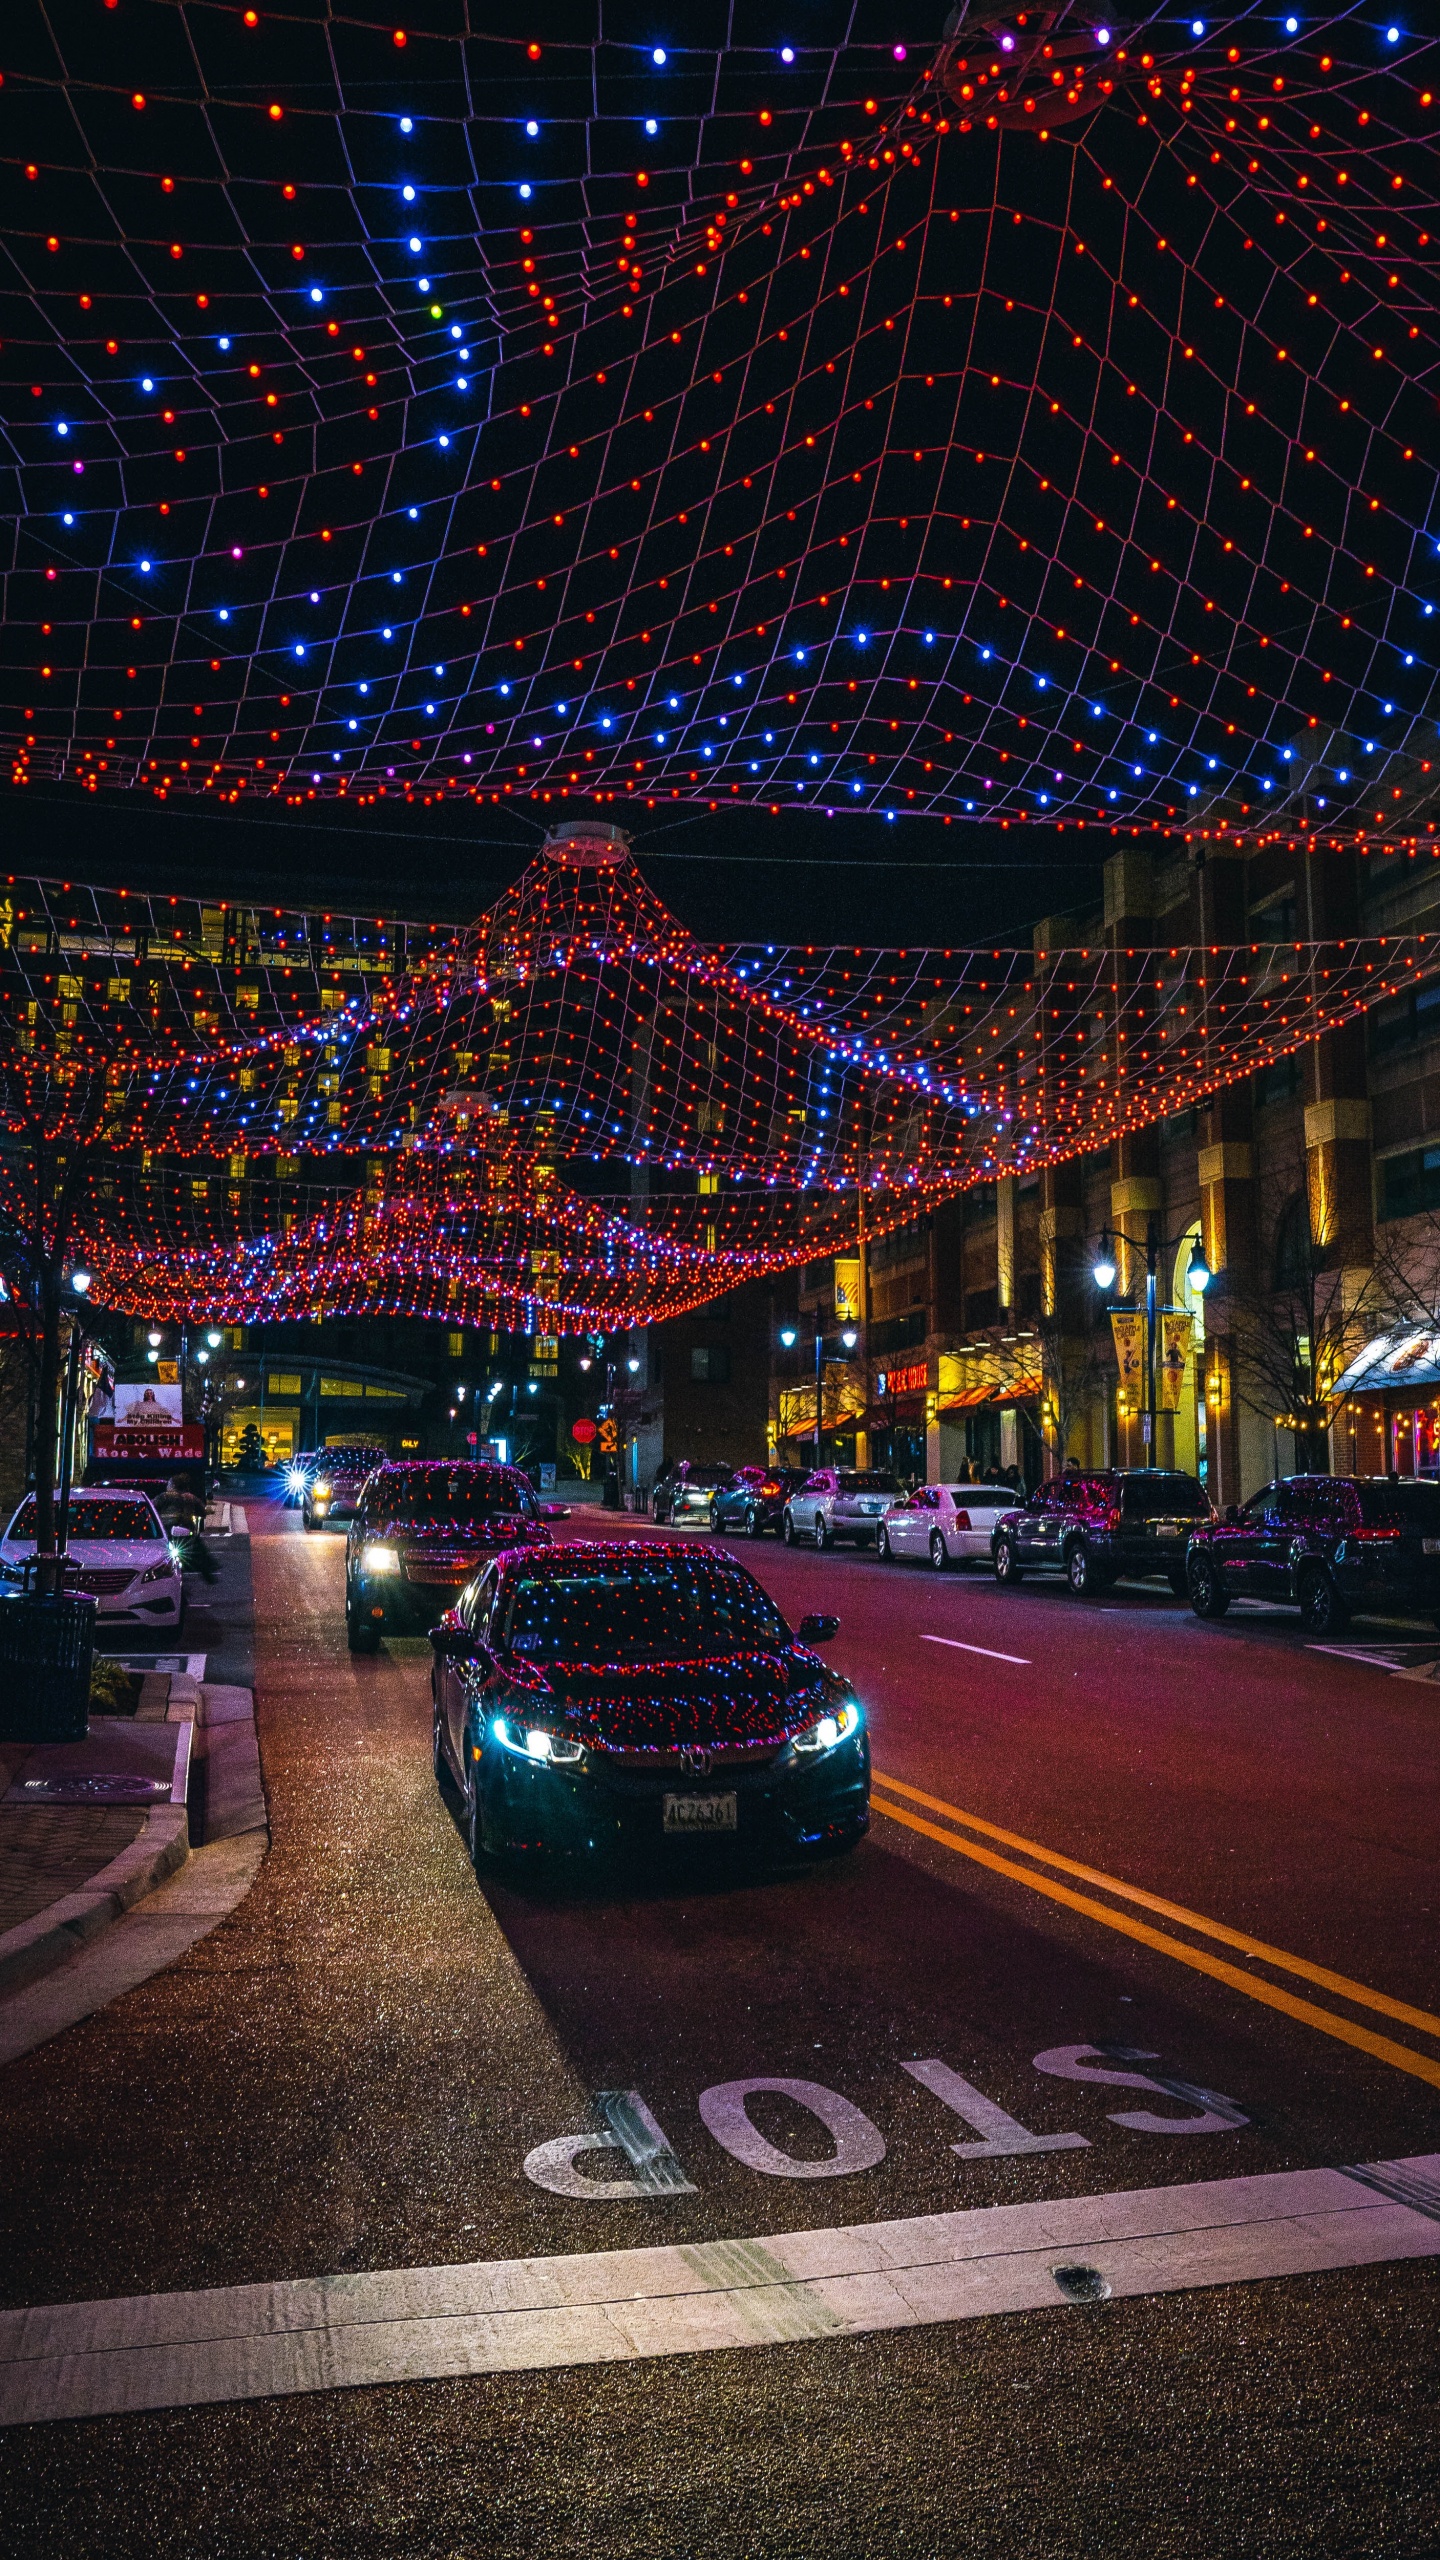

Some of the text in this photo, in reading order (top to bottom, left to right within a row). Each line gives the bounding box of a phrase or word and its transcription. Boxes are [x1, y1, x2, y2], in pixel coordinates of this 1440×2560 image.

[908, 1362, 928, 1390] HOUSE
[575, 1426, 594, 1435] STOP
[97, 1447, 129, 1458] Roe
[158, 1447, 202, 1458] Wade
[522, 2044, 1250, 2200] STOP
